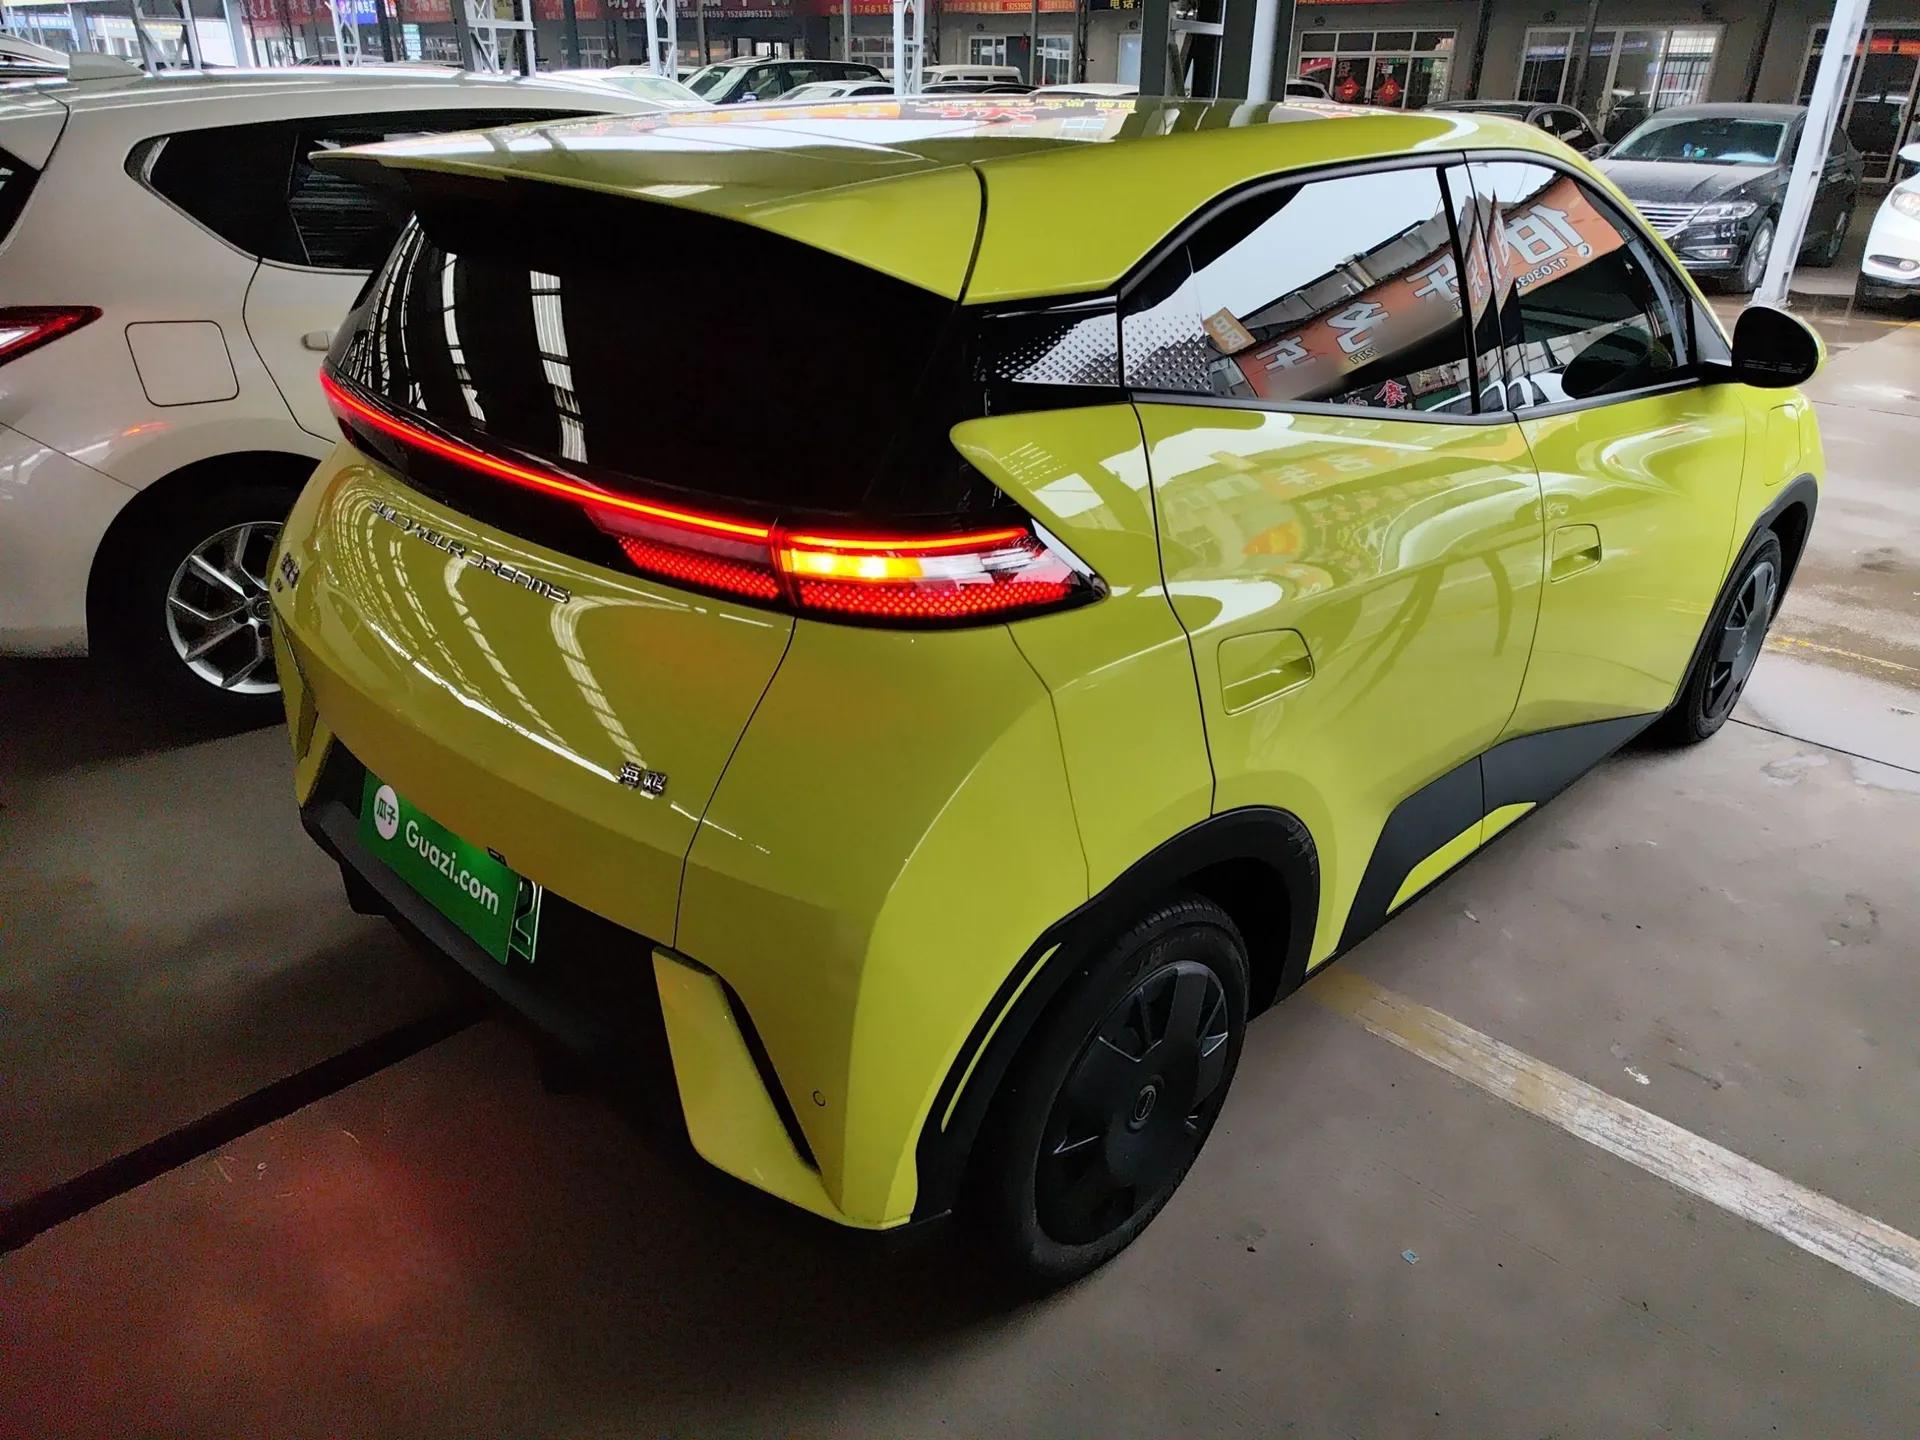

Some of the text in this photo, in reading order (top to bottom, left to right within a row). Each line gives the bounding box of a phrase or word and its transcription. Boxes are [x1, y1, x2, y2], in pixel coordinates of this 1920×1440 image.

[412, 523, 466, 560] YOUR
[466, 549, 572, 605] DREAMS
[376, 797, 397, 826] 瓜子
[405, 820, 500, 915] Guazi.com
